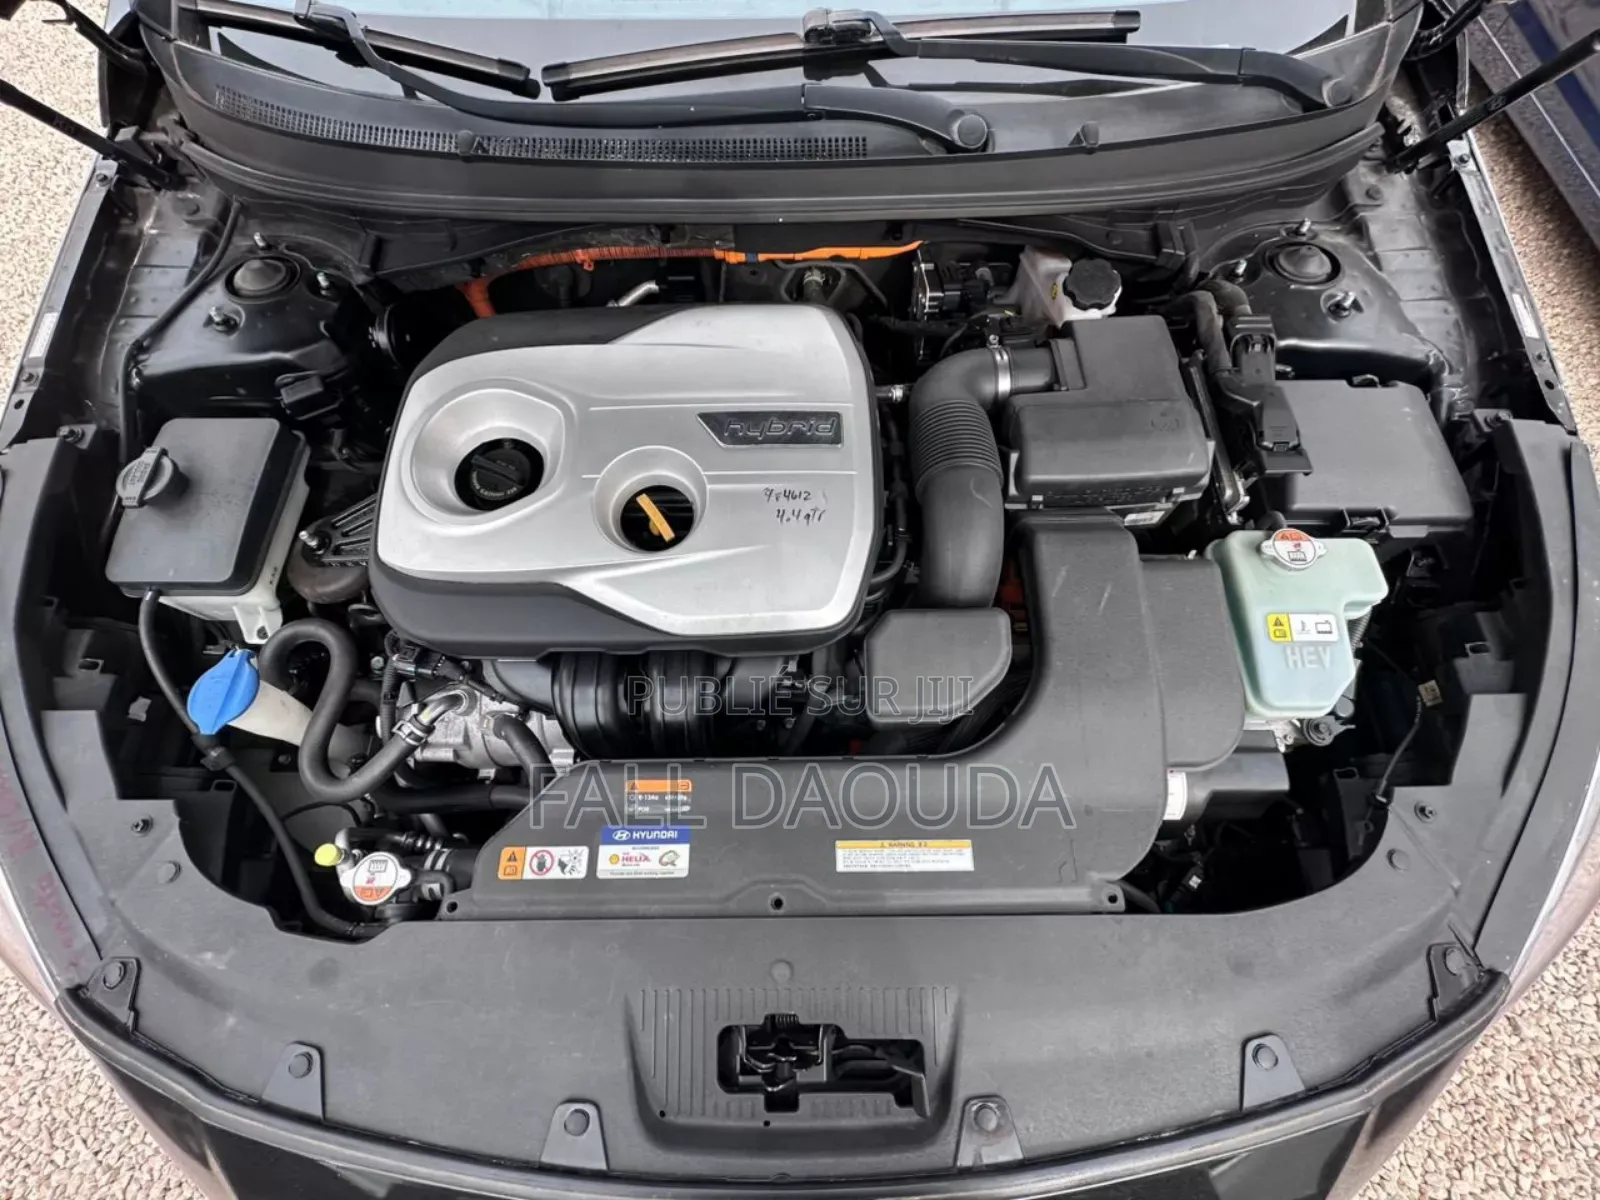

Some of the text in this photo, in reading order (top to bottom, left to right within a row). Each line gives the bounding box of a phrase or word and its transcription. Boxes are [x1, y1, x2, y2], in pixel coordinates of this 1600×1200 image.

[724, 416, 837, 440] hybrid
[1284, 645, 1332, 669] HEV
[632, 830, 678, 839] HYUNDAI
